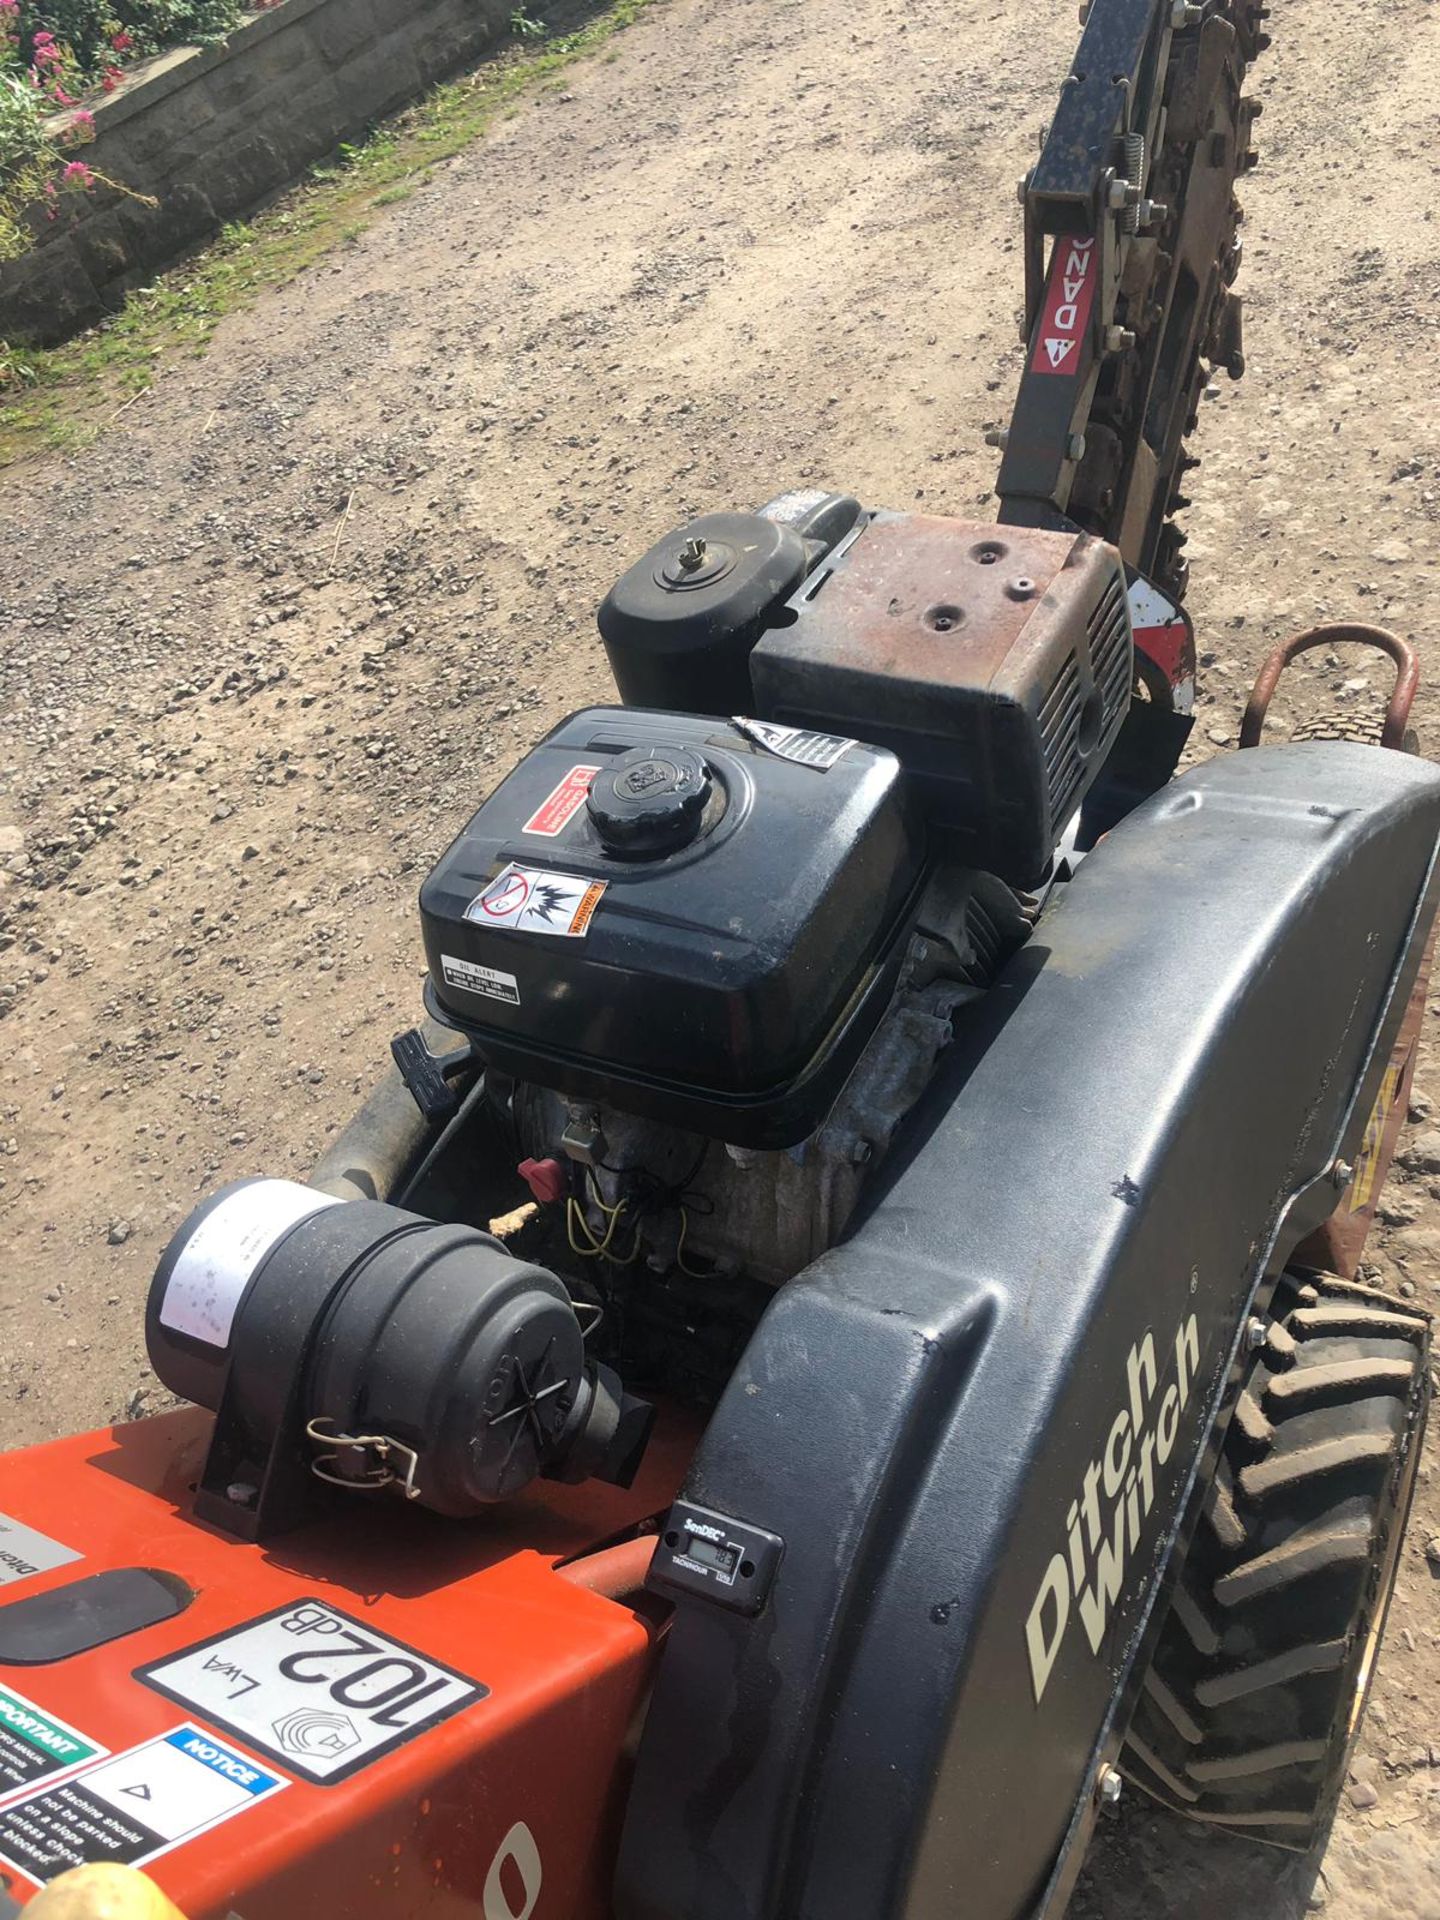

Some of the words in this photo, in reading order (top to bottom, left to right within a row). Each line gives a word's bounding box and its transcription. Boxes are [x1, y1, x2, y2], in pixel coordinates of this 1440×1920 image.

[1077, 1313, 1200, 1656] Witch
[1025, 1332, 1158, 1704] Ditch
[0, 1700, 79, 1754] PORTANT
[184, 1738, 261, 1786] NOTICE
[6, 1812, 46, 1840] unless
[24, 1804, 42, 1817] on
[40, 1815, 52, 1824] a
[50, 1822, 84, 1845] slope
[41, 1796, 64, 1811] not
[61, 1808, 79, 1822] be
[75, 1821, 123, 1850] parked
[58, 1788, 104, 1819] Machine
[102, 1815, 144, 1845] should
